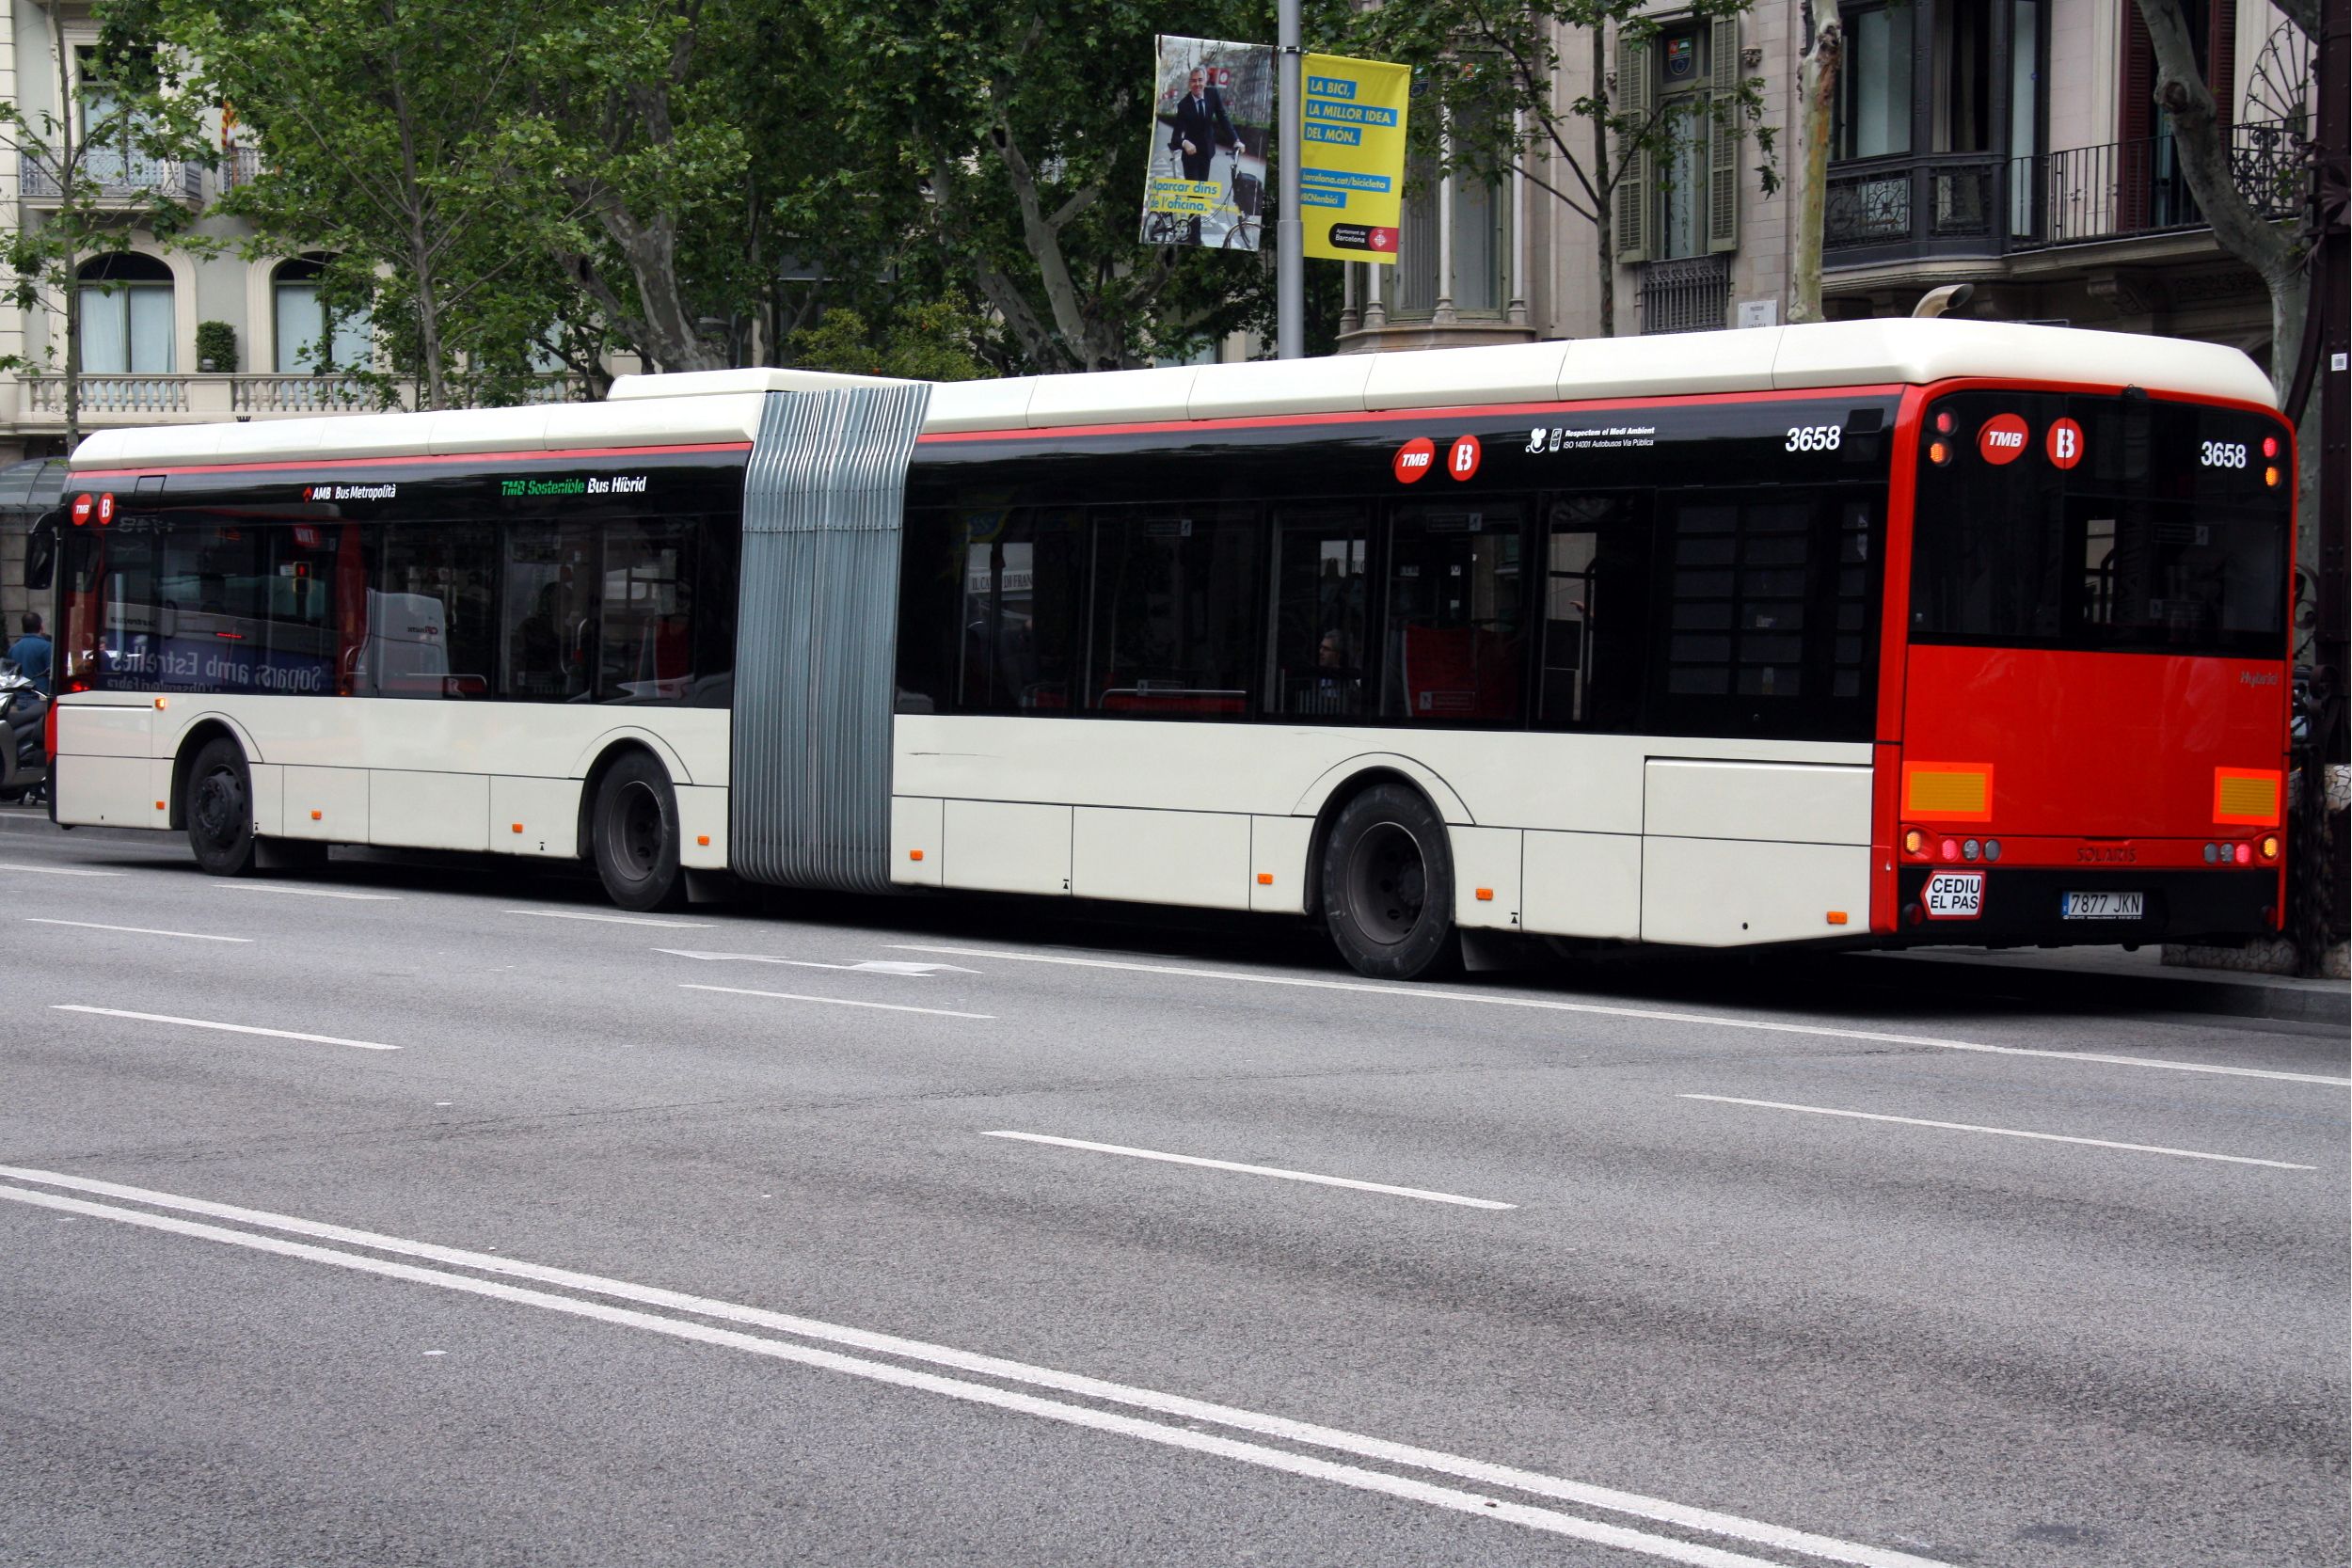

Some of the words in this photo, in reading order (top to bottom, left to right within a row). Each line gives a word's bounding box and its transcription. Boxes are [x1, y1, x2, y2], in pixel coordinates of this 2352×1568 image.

[1311, 79, 1324, 92] LA
[1327, 82, 1350, 97] BICI,
[1309, 103, 1320, 115] LA
[1324, 105, 1362, 120] MILLOR
[1365, 109, 1391, 124] IDEA
[1306, 126, 1322, 139] DEL
[1325, 126, 1356, 143] MÓN.
[1193, 181, 1217, 195] dins
[1150, 196, 1159, 208] de
[1335, 233, 1366, 244] Barcelona
[1565, 430, 1600, 438] Respectem
[1610, 427, 1627, 436] Medi
[1627, 426, 1655, 435] Ambient
[1785, 425, 1841, 452] 3658
[1989, 431, 2023, 448] TMB
[1563, 440, 1574, 449] ISO
[1575, 440, 1591, 449] 14001
[1591, 439, 1622, 448] Autobusos
[2056, 428, 2075, 458] B
[1402, 452, 1429, 467] TMB
[1455, 444, 1473, 471] B
[2201, 440, 2247, 468] 3658
[311, 487, 331, 500] AMB
[335, 485, 350, 499] Bus
[350, 483, 396, 501] Metropolità
[501, 480, 524, 496] TMB
[528, 478, 585, 495] Sostenible
[587, 477, 610, 494] Bus
[612, 476, 647, 493] Híbrid
[75, 504, 89, 515] TMB
[102, 499, 111, 518] B
[2240, 671, 2278, 688] Hybrid
[2076, 847, 2137, 863] SOLARIS
[1931, 878, 1980, 894] CEDIU
[1931, 895, 1947, 910] EL
[1951, 895, 1979, 910] PAS
[2072, 894, 2108, 913] 7877
[2113, 894, 2140, 913] JKN
